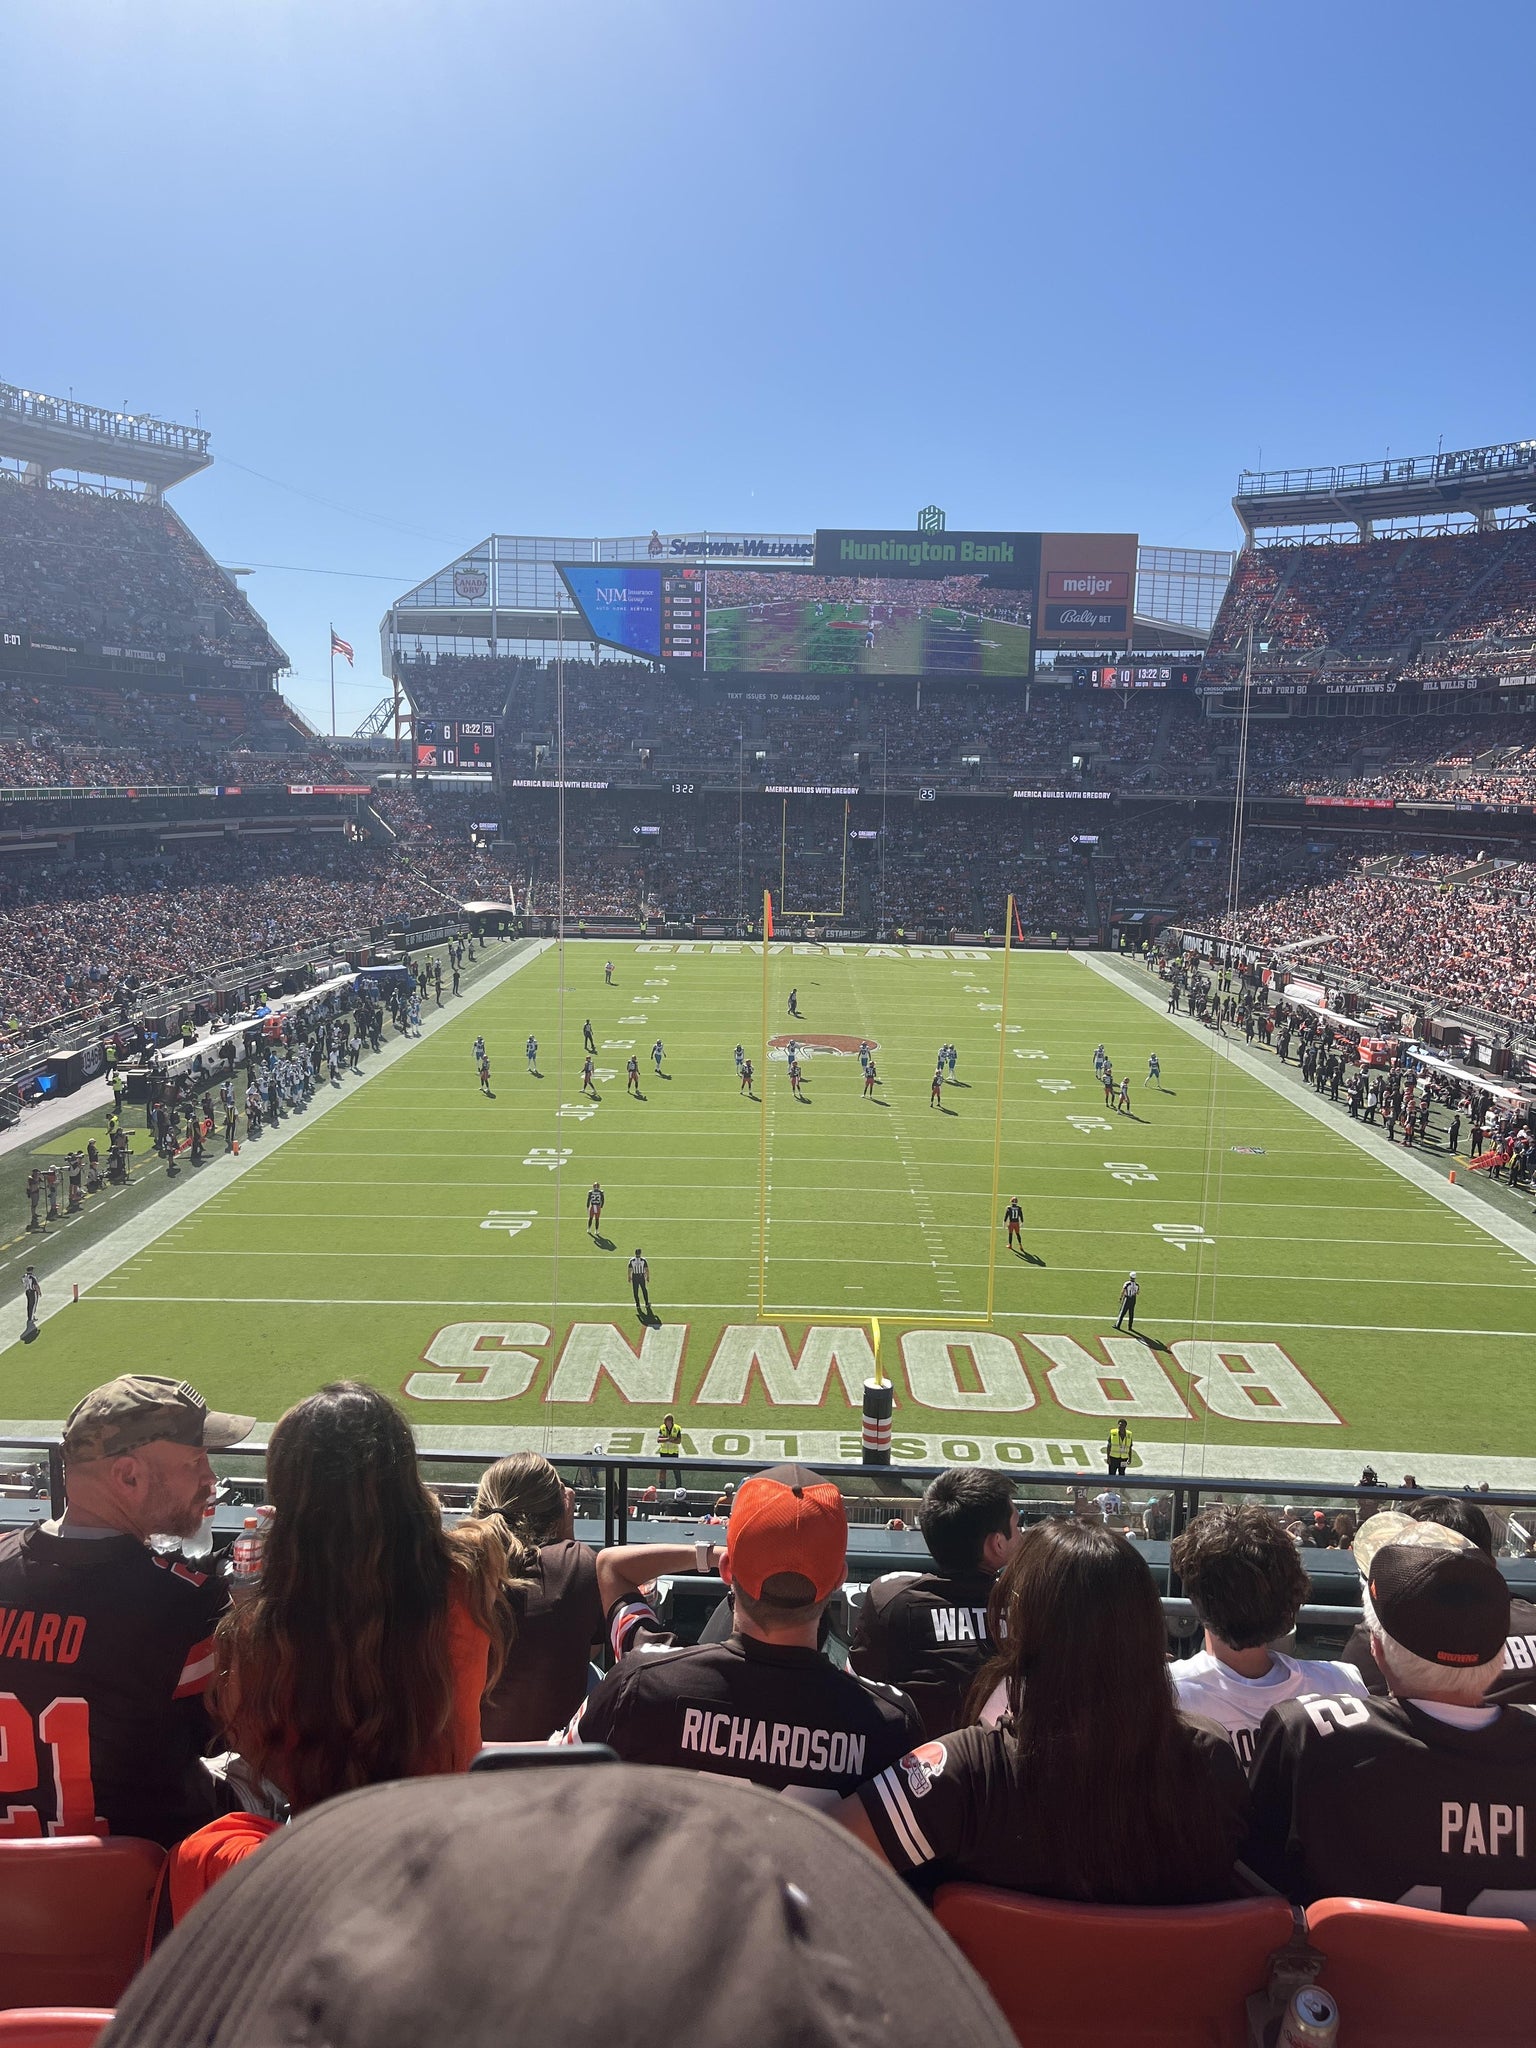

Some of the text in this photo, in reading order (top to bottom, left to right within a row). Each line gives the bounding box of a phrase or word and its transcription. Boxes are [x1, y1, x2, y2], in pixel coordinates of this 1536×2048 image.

[669, 538, 815, 557] SHERWIN-WILLIAMS
[840, 539, 1014, 567] Huntington Bank
[455, 579, 488, 587] CANADA
[1063, 575, 1113, 596] meijer
[463, 586, 480, 594] DRY
[596, 588, 627, 604] NJM
[627, 588, 654, 596] Insurance
[1060, 609, 1112, 626] Bally BET
[4, 633, 21, 646] 0:07
[102, 645, 166, 662] BOBBY MITCHELL 49
[1091, 670, 1098, 682] 6
[1120, 670, 1130, 682] 10
[1138, 668, 1157, 679] 13:22
[1161, 669, 1170, 679] 25
[1257, 685, 1308, 694] LEN FORD 80
[1326, 683, 1397, 694] CLAY MATTHEWS 57
[1440, 681, 1465, 690] WILLIS
[1466, 680, 1478, 689] 60
[443, 725, 451, 739] 6
[462, 723, 480, 734] 13:22
[484, 725, 492, 734] 25
[443, 750, 454, 764] 10
[512, 779, 609, 789] AMERICA BUILDS WITH GREGORY
[765, 785, 859, 795] AMERICA BUILDS WITH GREGORY
[921, 789, 933, 799] 25
[1013, 790, 1042, 798] AMERICA
[1065, 791, 1082, 799] WITH
[1182, 934, 1203, 953] HOME
[634, 943, 992, 961] CLEVELAND
[522, 1147, 574, 1166] 20
[1103, 1161, 1159, 1182] 20
[479, 1209, 539, 1231] 10
[1011, 1209, 1019, 1219] 11
[1152, 1223, 1216, 1245] 10
[403, 1320, 1350, 1426] BROWNS
[681, 1707, 867, 1776] RICHARDSON
[1441, 1801, 1525, 1857] PAPI
